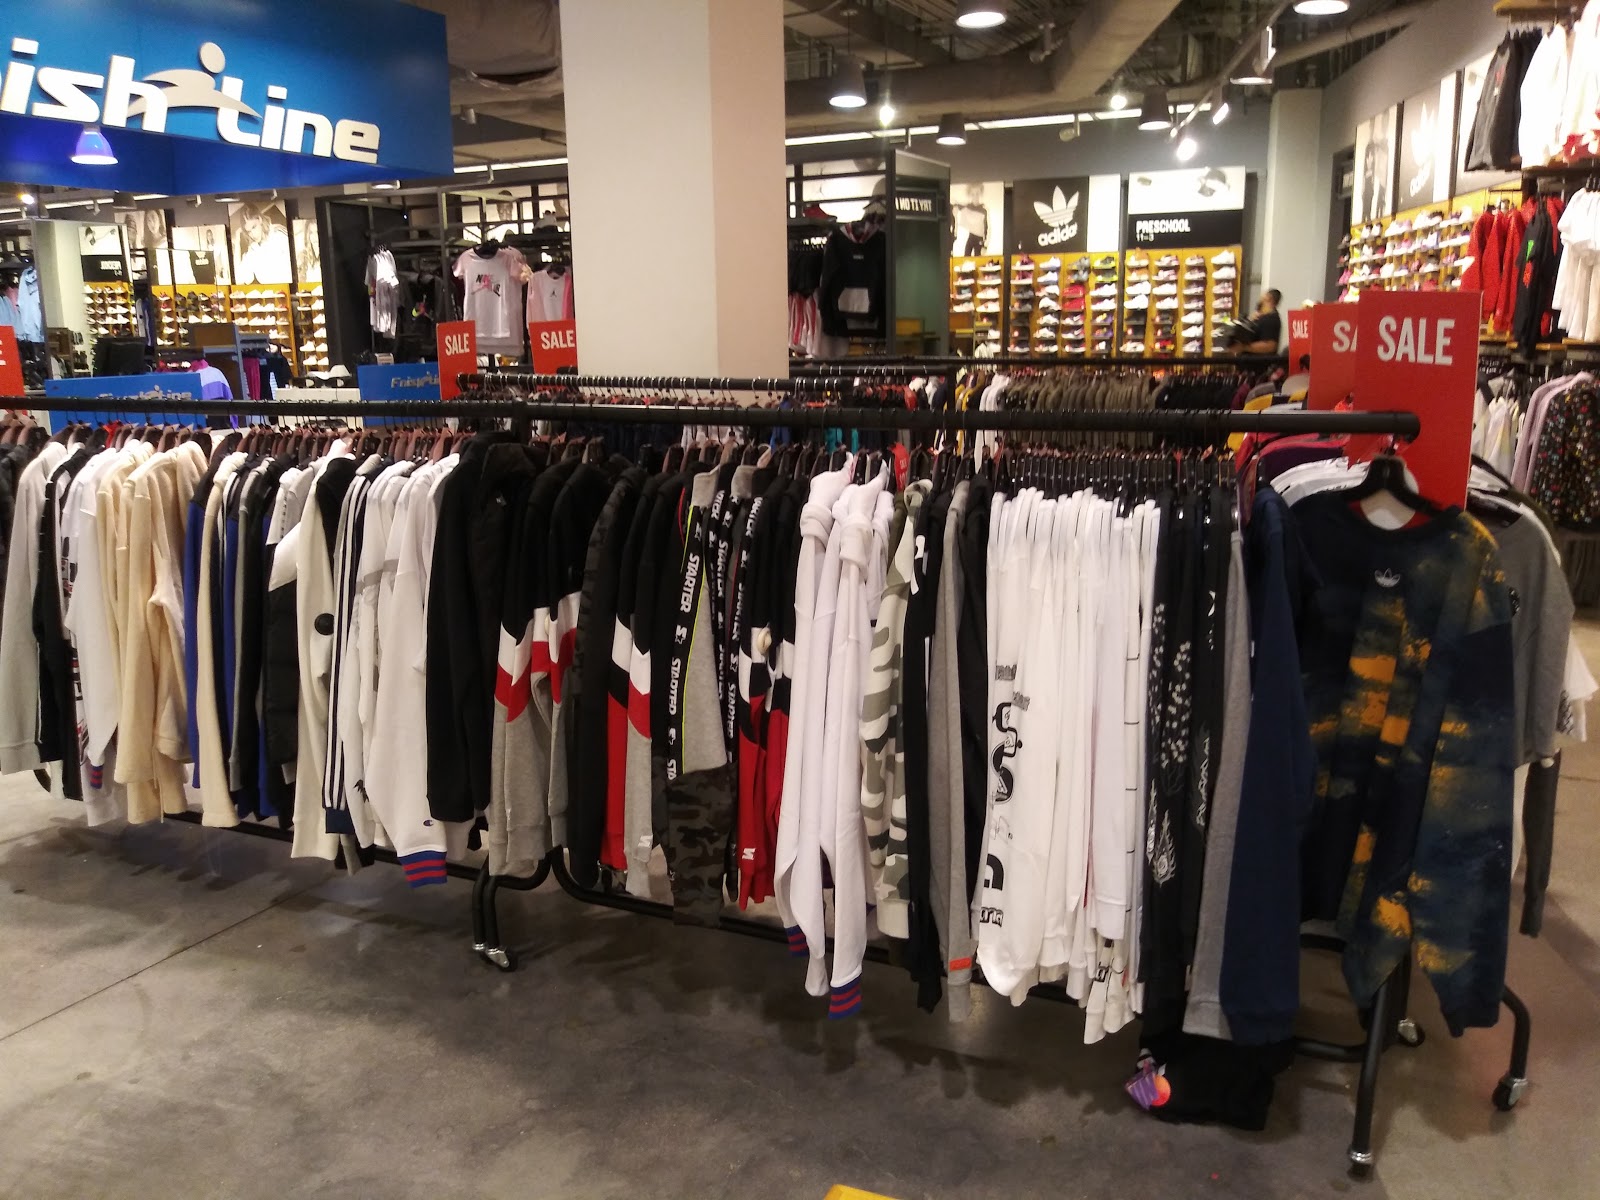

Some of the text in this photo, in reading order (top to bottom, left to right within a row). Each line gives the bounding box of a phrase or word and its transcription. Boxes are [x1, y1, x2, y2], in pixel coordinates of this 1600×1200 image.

[0, 37, 168, 133] ish
[1136, 218, 1191, 234] PRESCHOOL
[540, 329, 576, 351] SALE
[1292, 319, 1309, 340] SALE
[1376, 314, 1456, 366] SALE
[444, 332, 470, 356] SALE
[680, 552, 700, 613] STARTER
